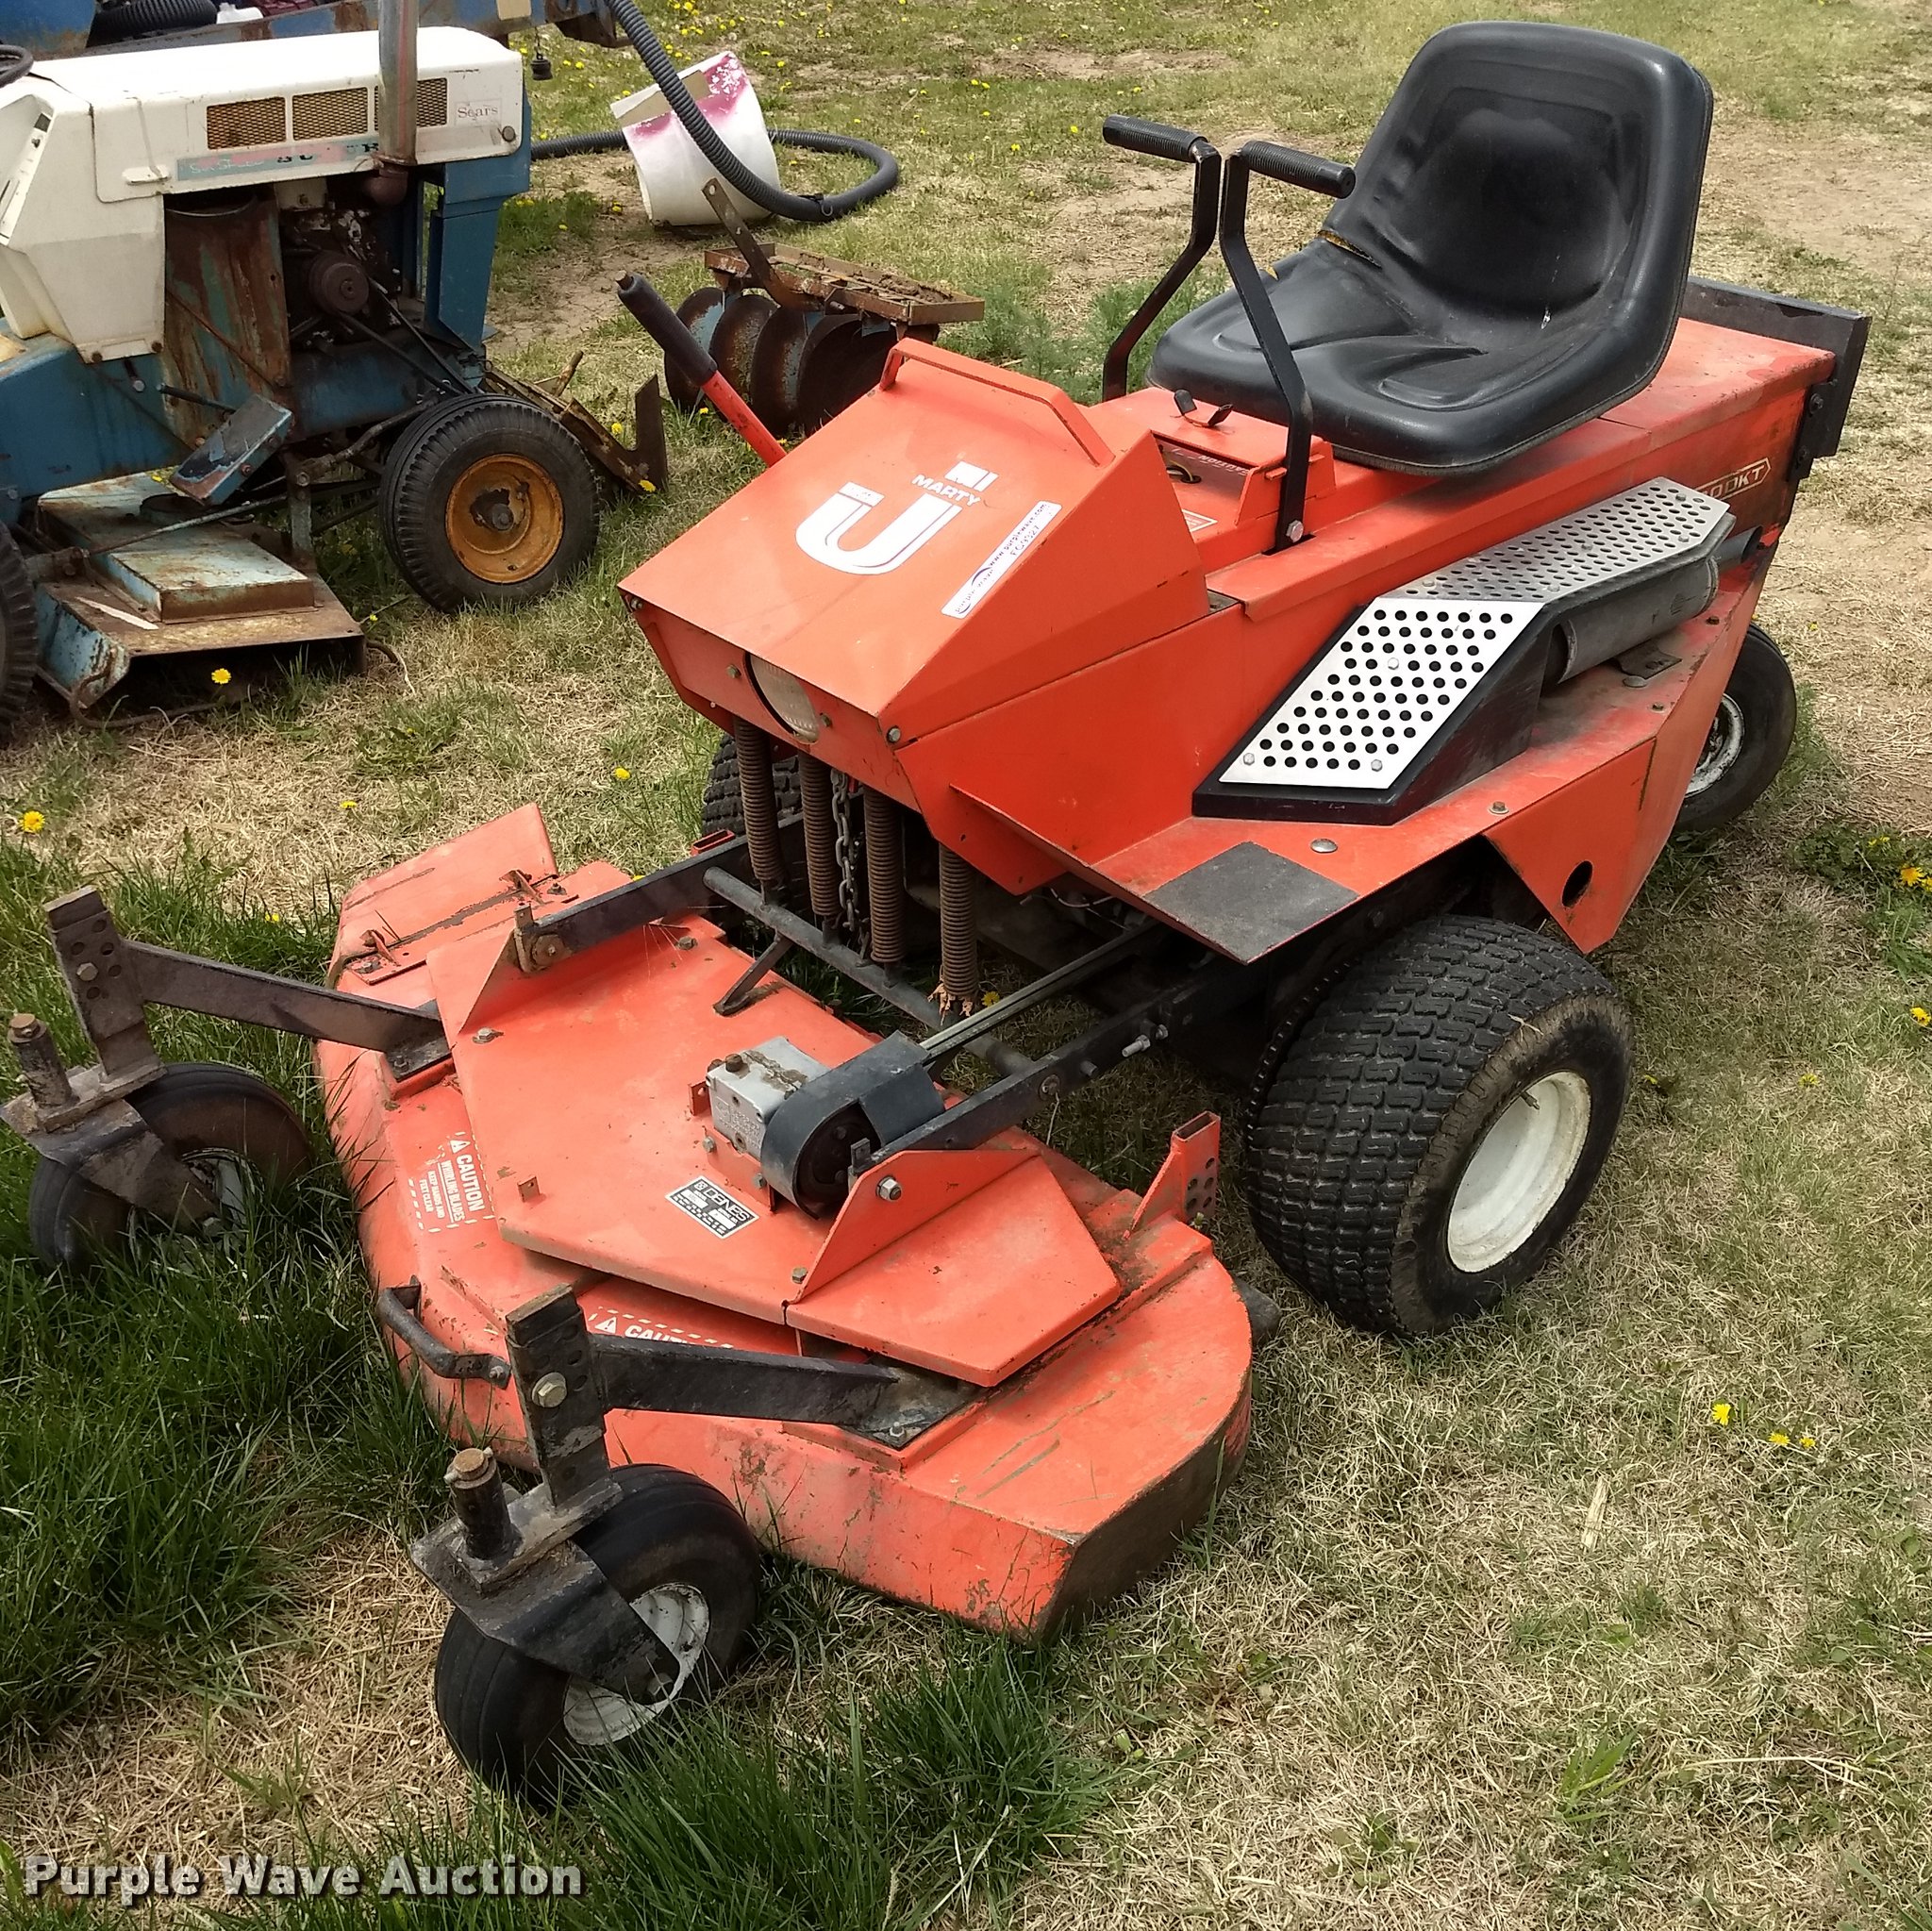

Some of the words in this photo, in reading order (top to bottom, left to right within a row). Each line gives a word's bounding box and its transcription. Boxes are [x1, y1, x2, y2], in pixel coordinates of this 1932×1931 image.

[457, 105, 498, 119] Sears
[911, 474, 981, 507] MARTY
[441, 1159, 458, 1193] WHIRLING
[456, 1154, 486, 1211] CAUTION
[448, 1192, 465, 1222] BLADES
[703, 1188, 750, 1222] DENES
